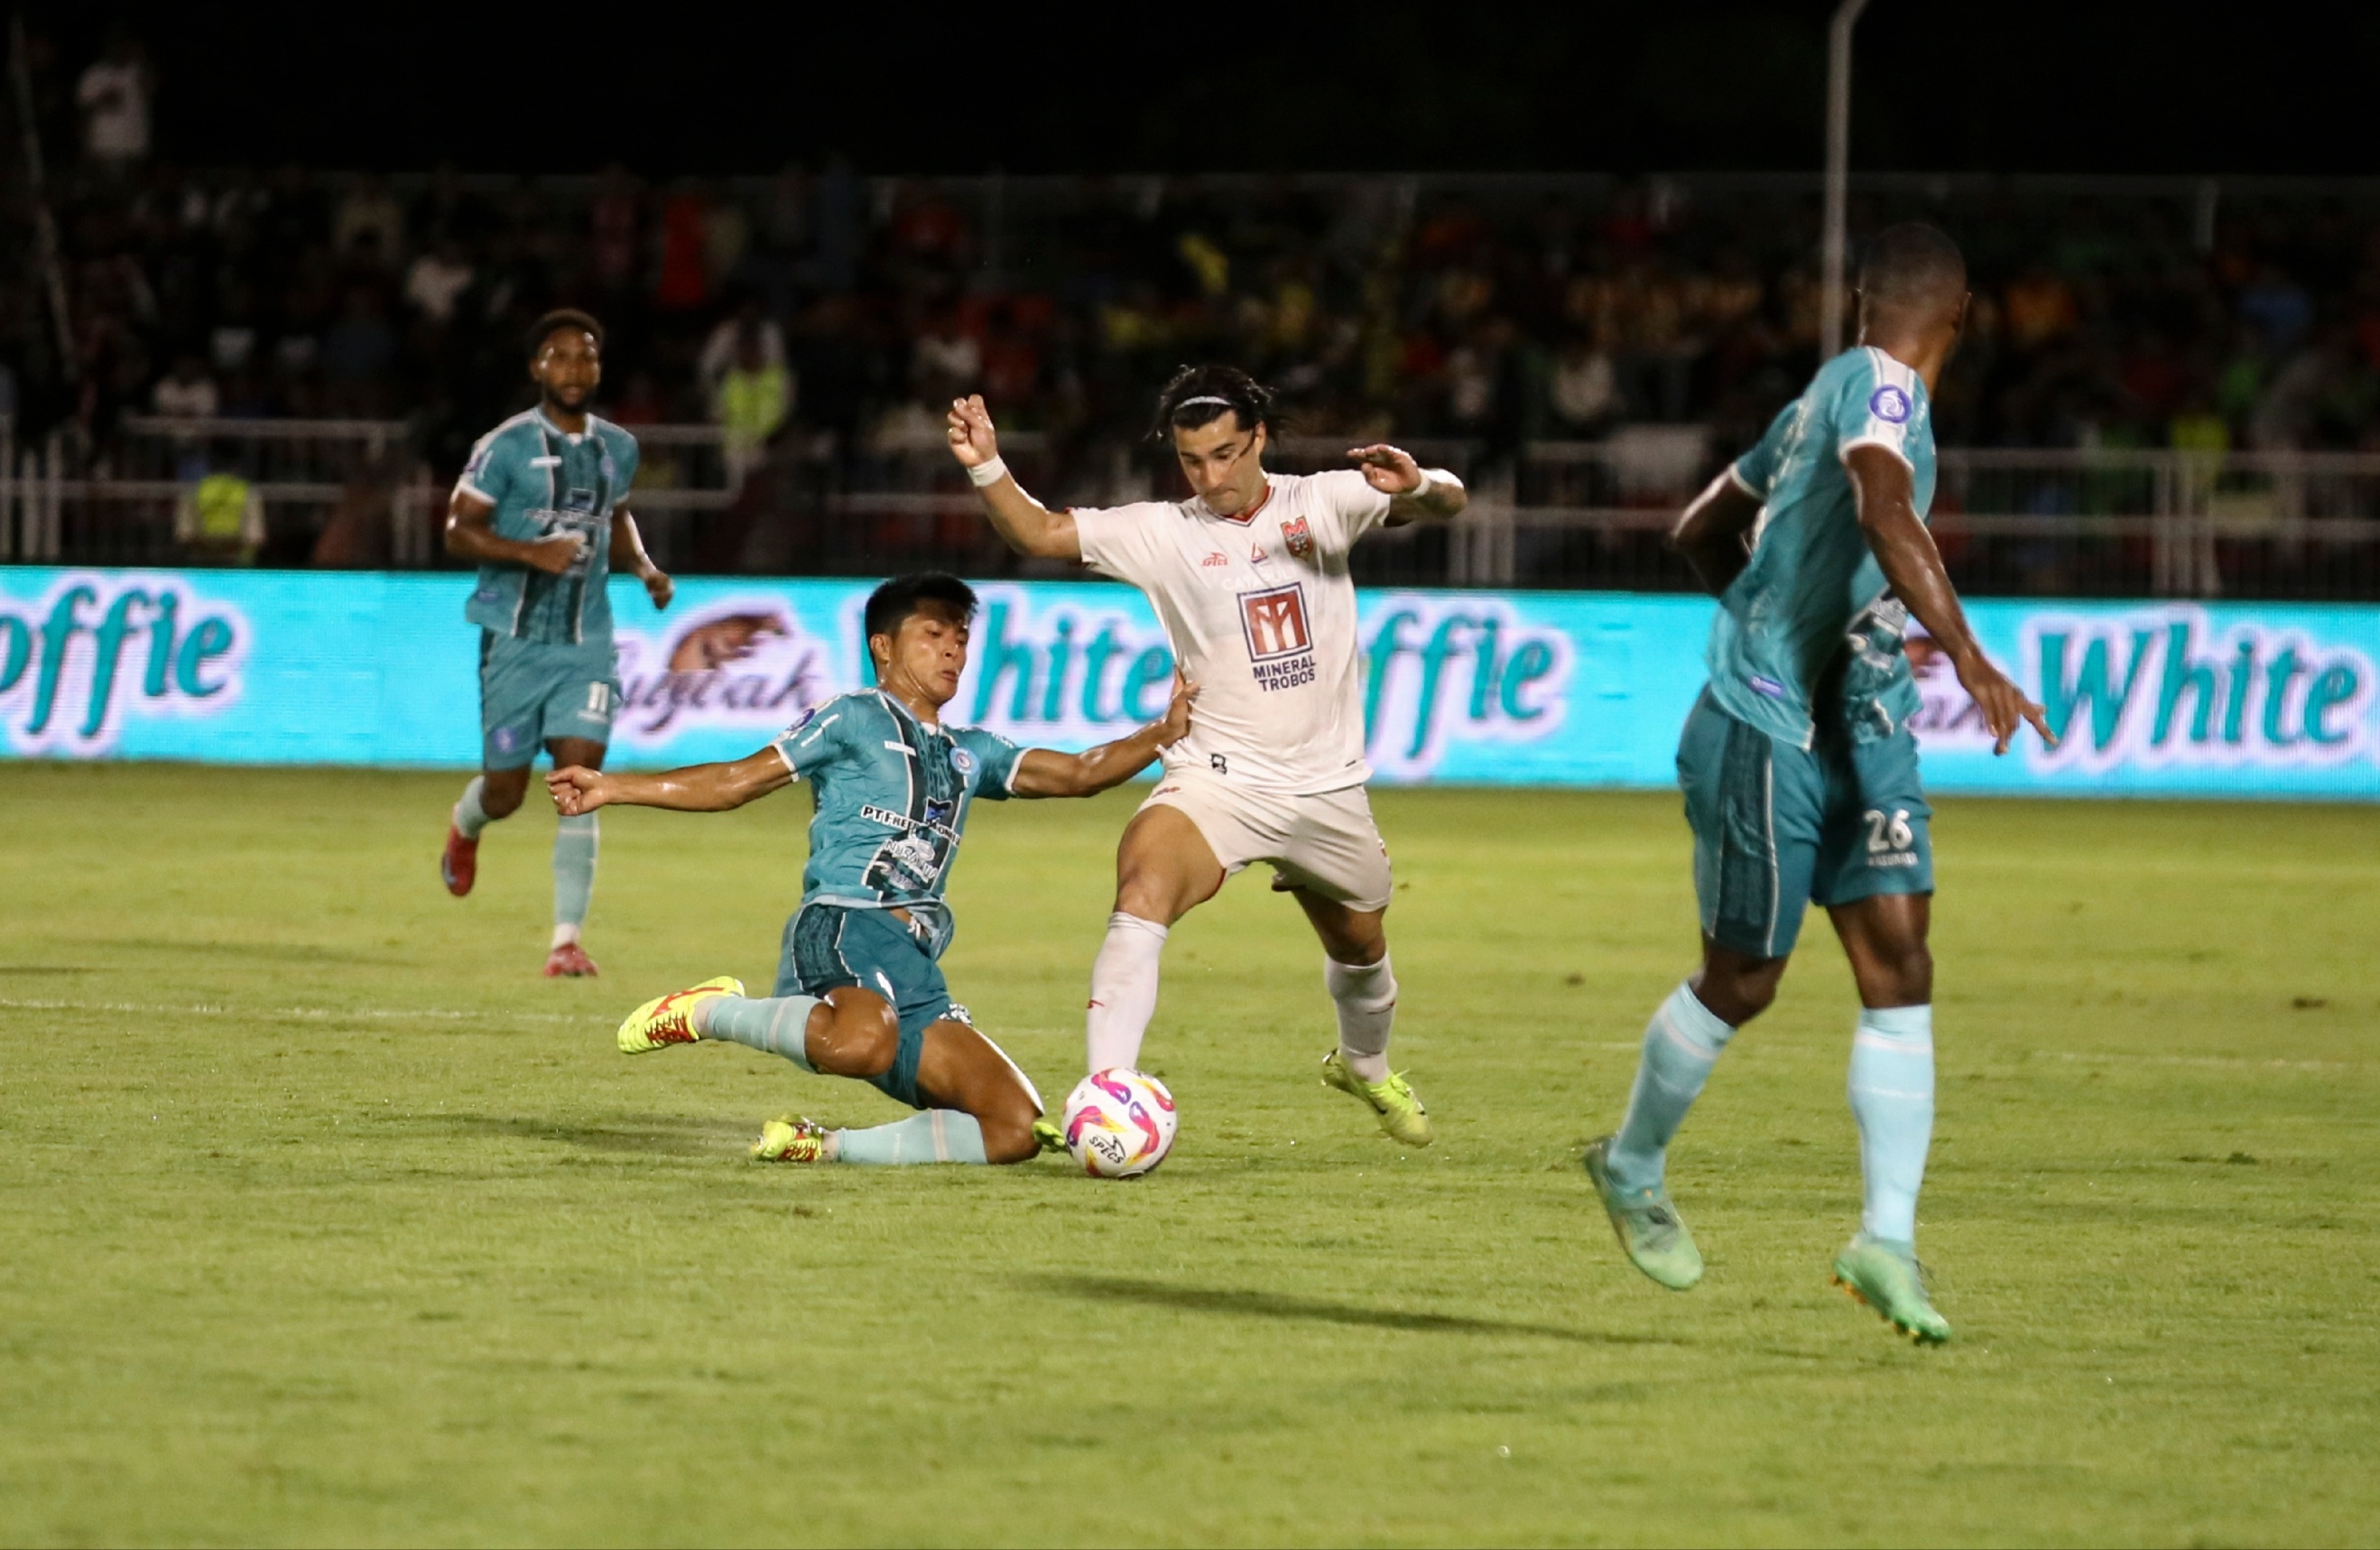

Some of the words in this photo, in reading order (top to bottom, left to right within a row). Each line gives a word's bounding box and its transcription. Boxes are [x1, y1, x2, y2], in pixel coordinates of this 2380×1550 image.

[859, 601, 1173, 723] hite
[1252, 654, 1317, 679] MINERAL
[1258, 668, 1315, 692] TROBOS
[2039, 622, 2358, 752] White
[588, 681, 609, 713] 11
[1864, 808, 1913, 853] 26
[1088, 1136, 1125, 1165] SPECS
